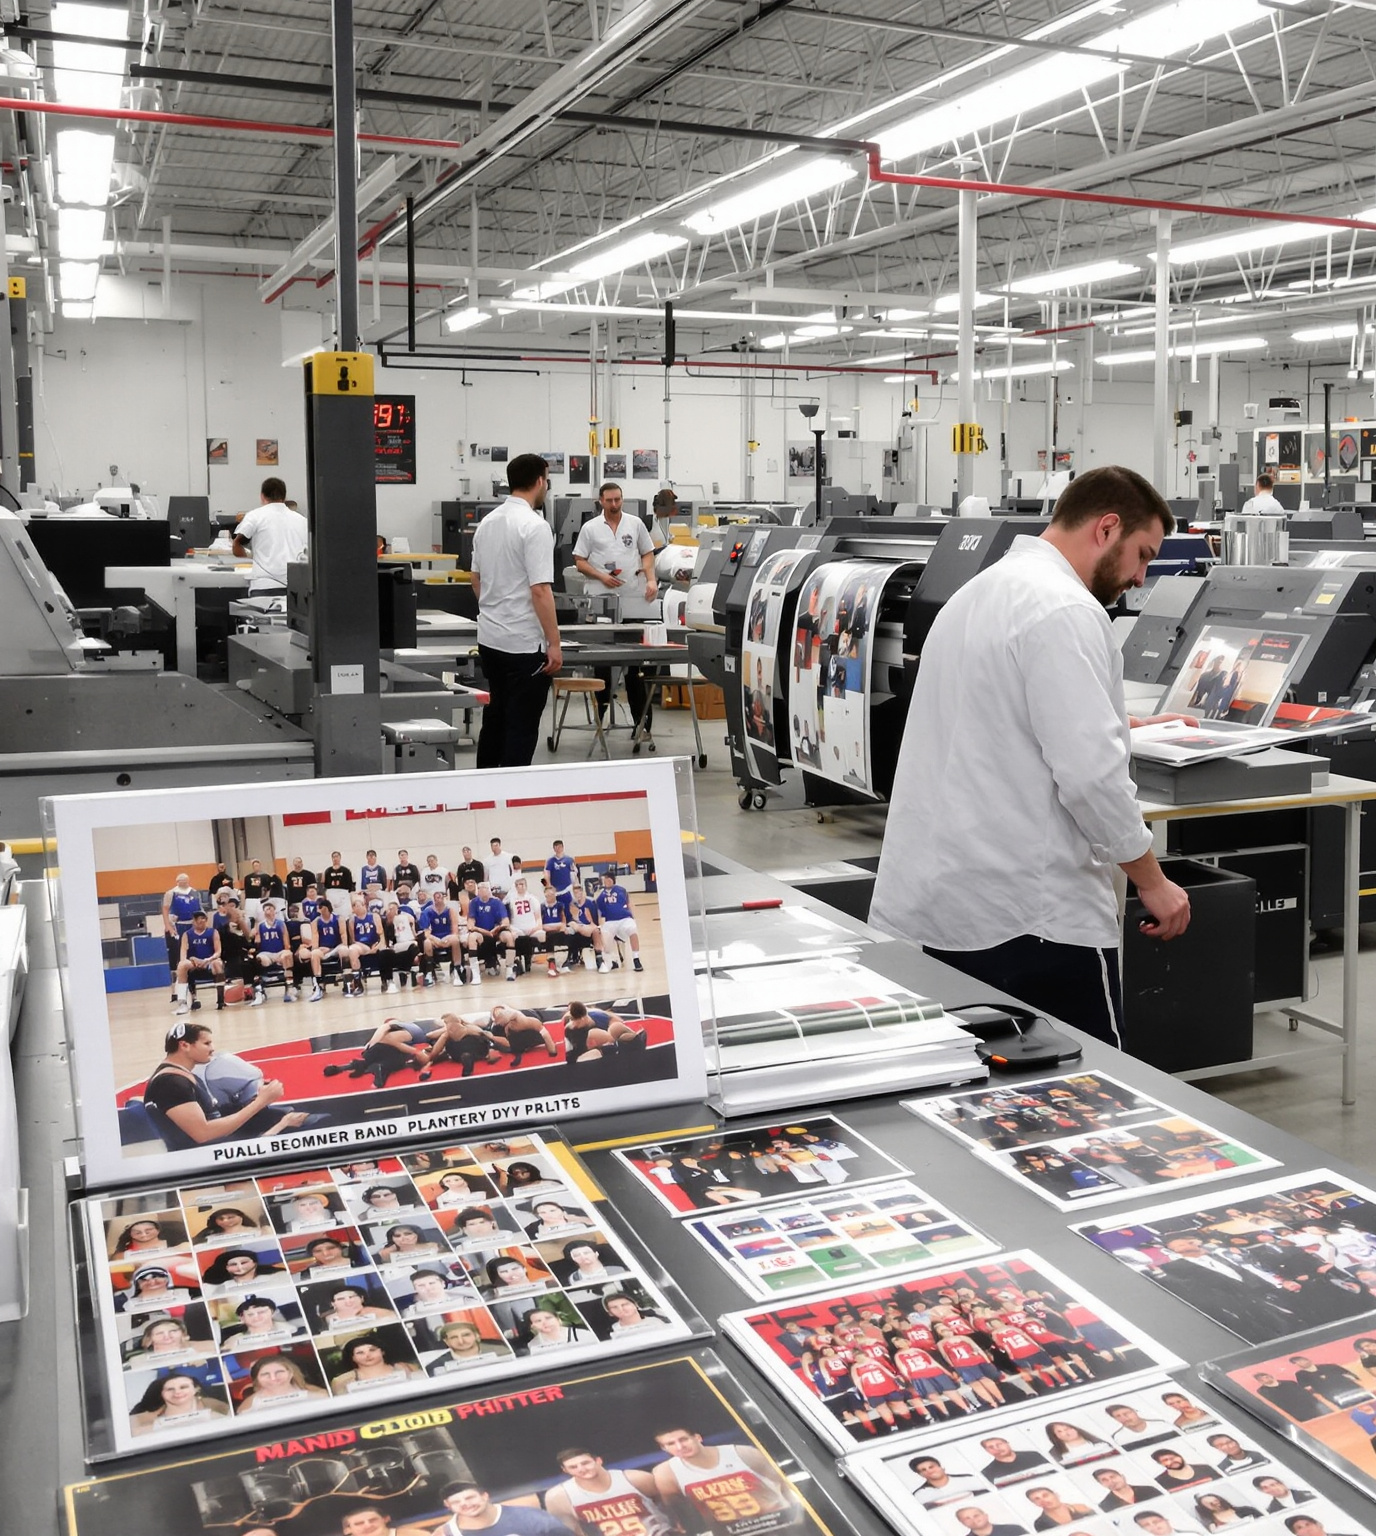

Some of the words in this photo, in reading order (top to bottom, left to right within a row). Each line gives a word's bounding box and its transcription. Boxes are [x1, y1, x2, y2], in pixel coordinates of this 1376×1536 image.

[213, 1144, 266, 1161] PUALL
[270, 1131, 349, 1153] BEOMNER
[355, 1124, 398, 1140] BAND
[408, 1111, 487, 1132] PLANTERY
[492, 1106, 520, 1120] DYY
[456, 1385, 565, 1420] PHITTER
